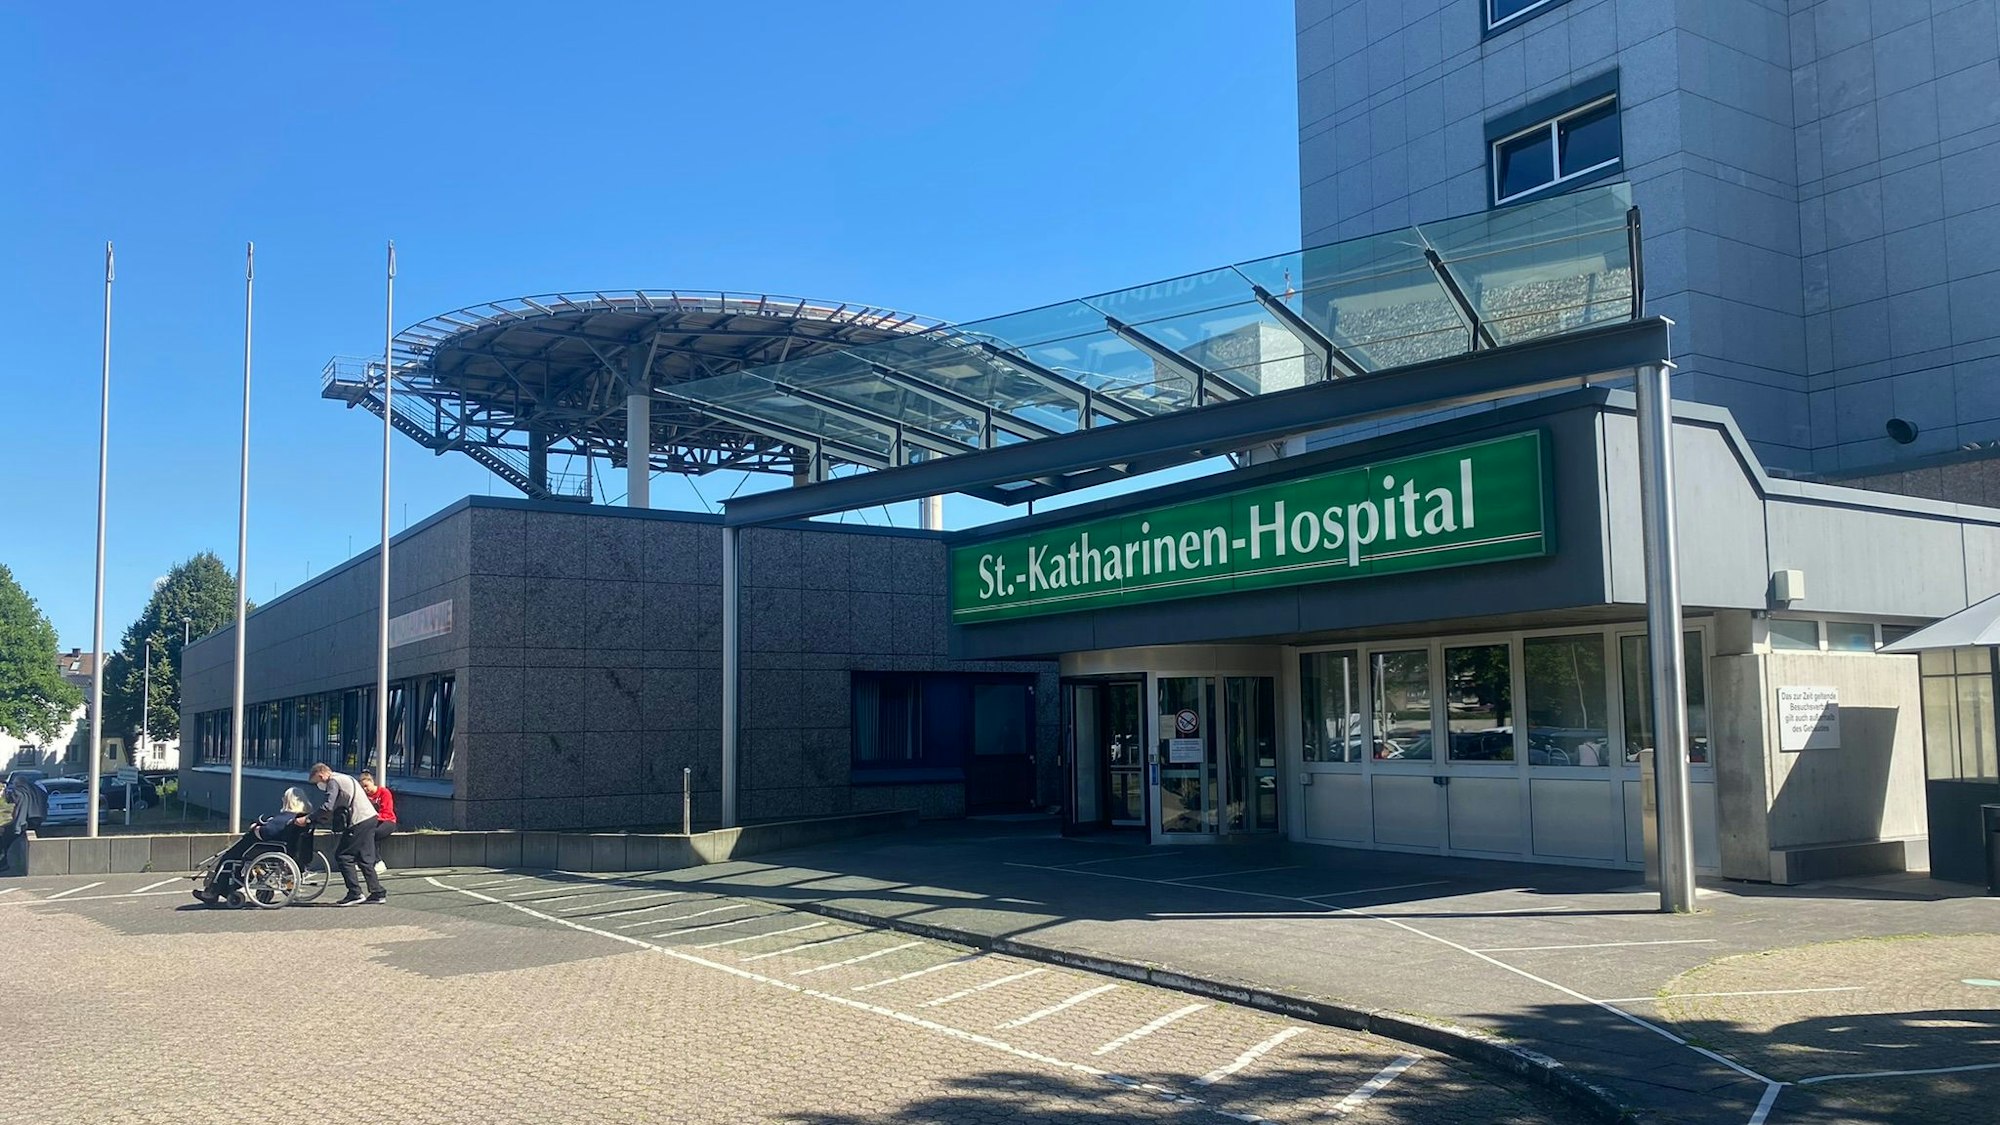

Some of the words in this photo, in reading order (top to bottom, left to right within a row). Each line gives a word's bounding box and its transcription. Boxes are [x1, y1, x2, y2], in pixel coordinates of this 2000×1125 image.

[978, 458, 1476, 600] St.-Katharinen-Hospital
[1781, 692, 1792, 700] Das
[1803, 692, 1813, 700] Zeit
[1814, 692, 1836, 702] geltende
[1785, 714, 1794, 723] gilt
[1792, 724, 1802, 732] des
